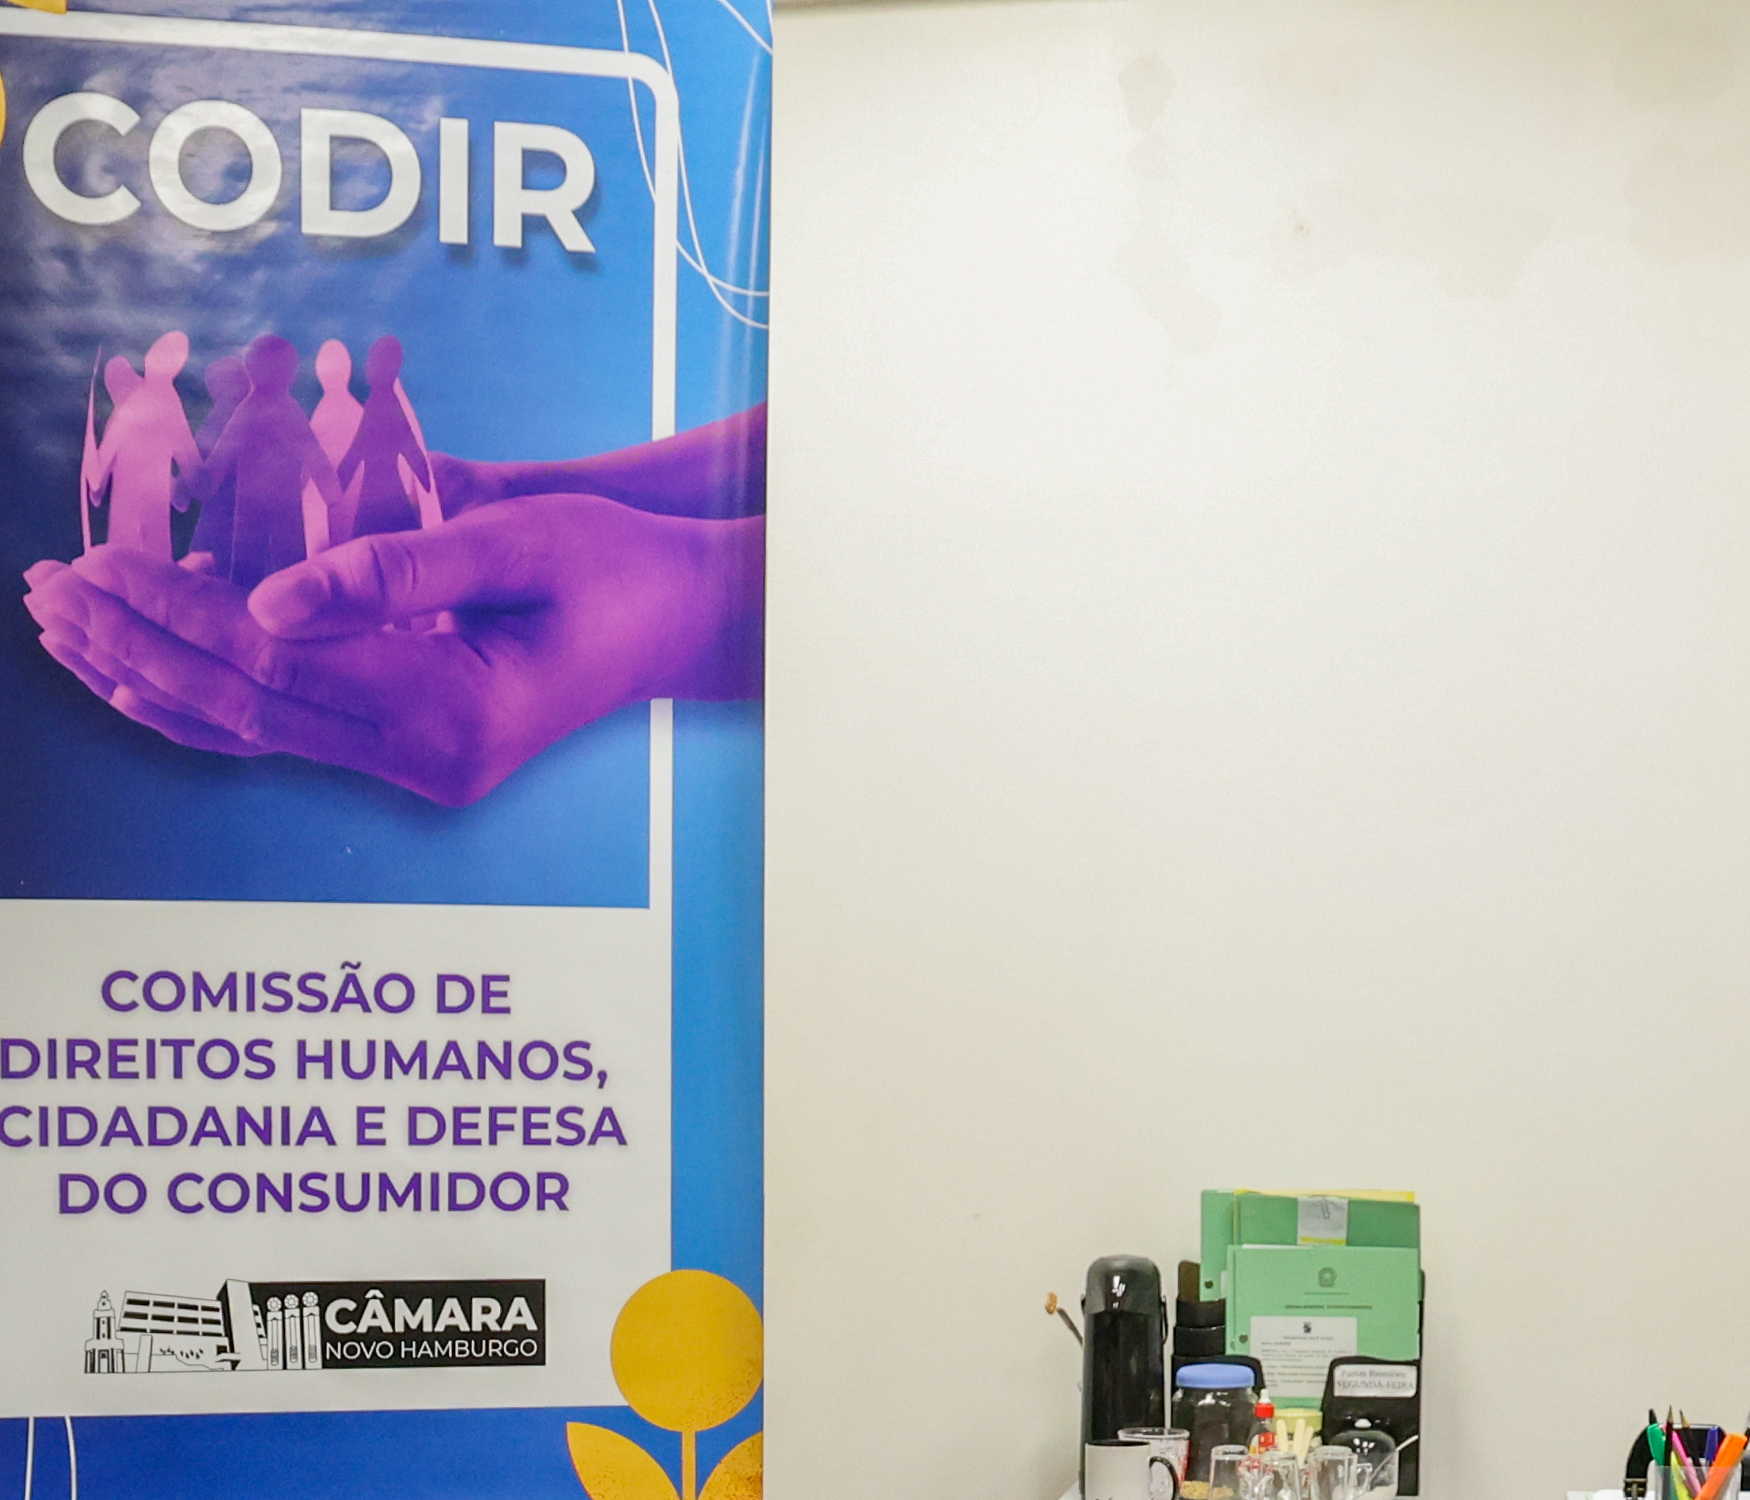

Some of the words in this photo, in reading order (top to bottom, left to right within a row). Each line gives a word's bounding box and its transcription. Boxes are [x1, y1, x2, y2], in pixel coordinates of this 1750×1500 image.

[23, 92, 596, 254] CODIR
[101, 961, 416, 1014] COMISSÃO
[436, 973, 511, 1014] DE
[0, 1038, 276, 1081] DIREITOS
[297, 1039, 608, 1089] HUMANOS,
[356, 1106, 387, 1146] E
[408, 1106, 628, 1147] DEFESA
[58, 1173, 148, 1215] DO
[167, 1172, 570, 1215] CONSUMIDOR
[325, 1290, 538, 1334] CÂMARA
[325, 1341, 394, 1360] NOVO
[400, 1339, 538, 1359] HAMBURGO
[1336, 1380, 1414, 1390] SEGUNDA-FEIRA
